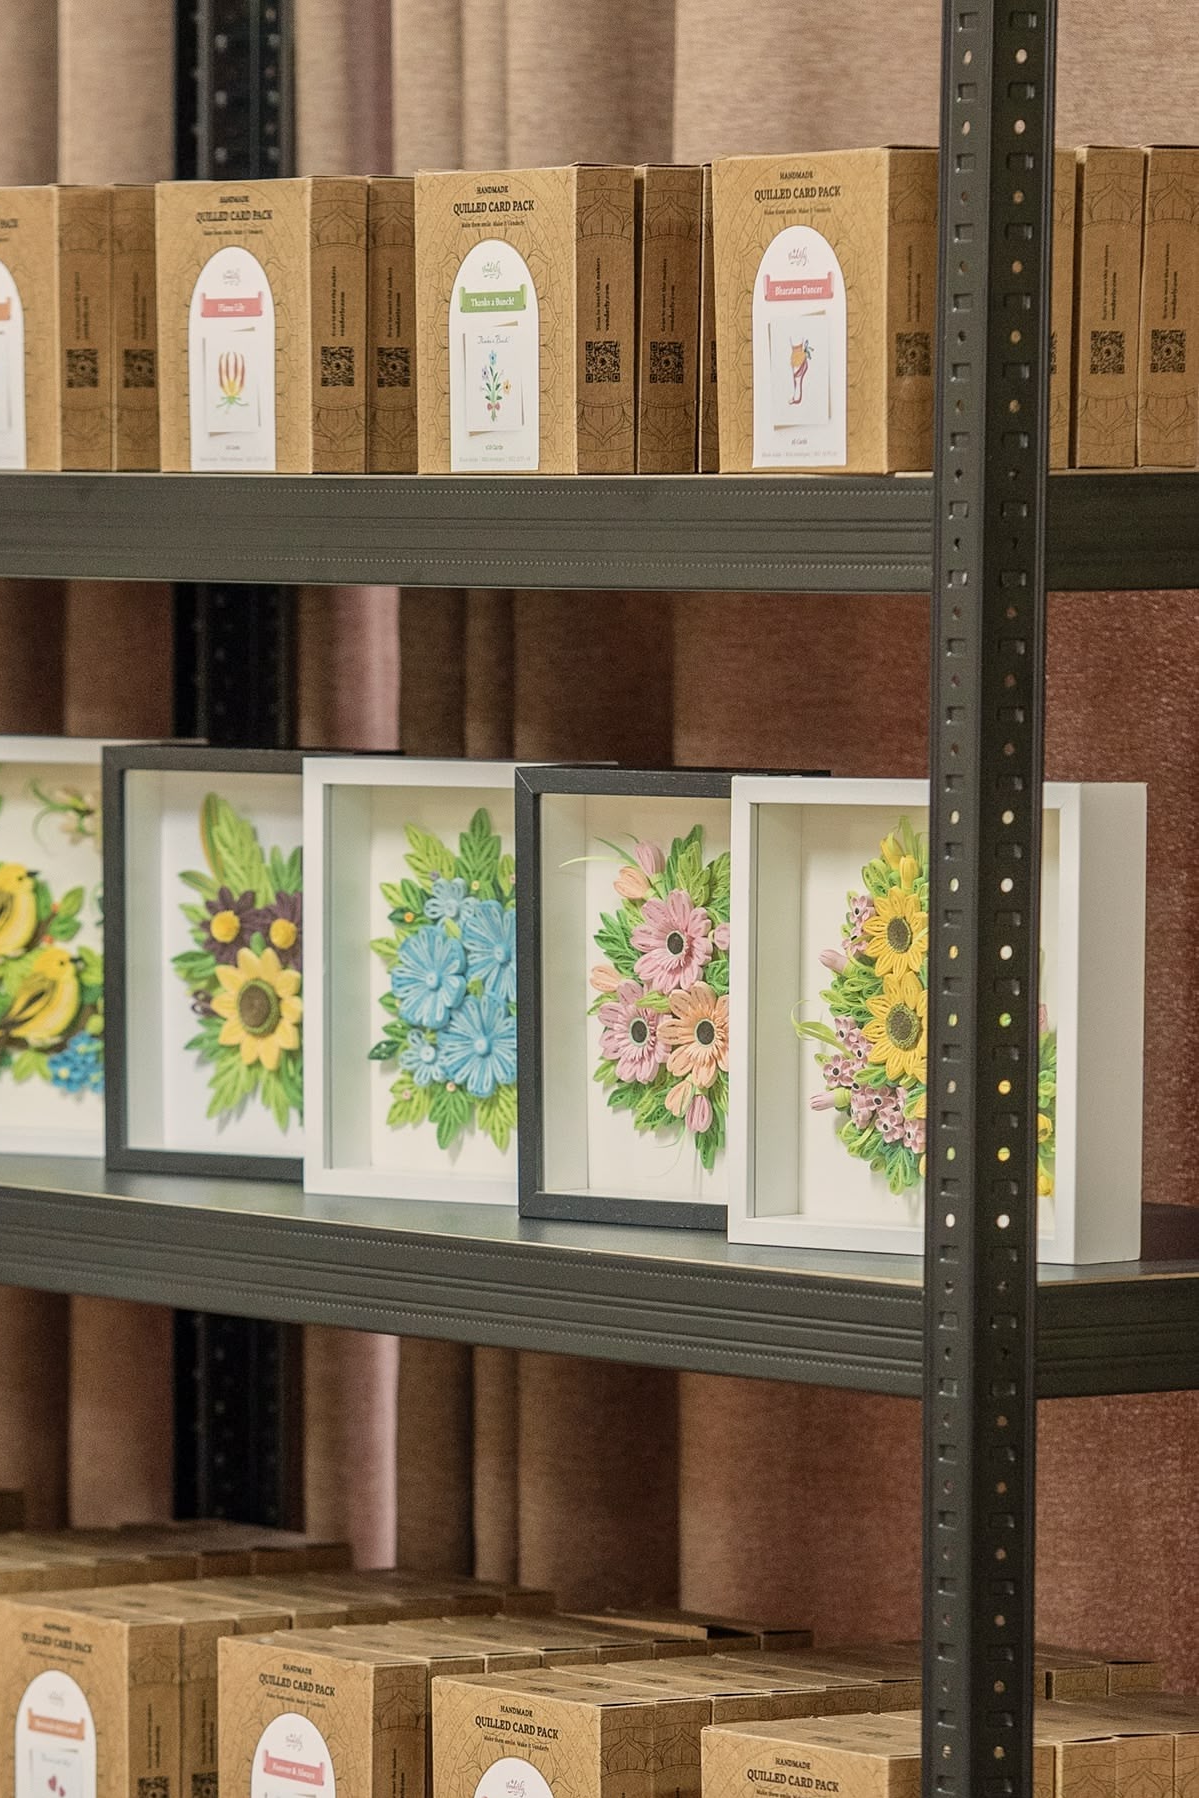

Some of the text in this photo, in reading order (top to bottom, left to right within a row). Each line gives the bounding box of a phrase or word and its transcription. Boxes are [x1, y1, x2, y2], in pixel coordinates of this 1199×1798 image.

[780, 170, 813, 180] HANDMADE
[476, 185, 509, 194] HANDMADE
[754, 185, 841, 203] QUILLED CARD PACK
[453, 200, 535, 216] QUILLED CARD PACK
[471, 298, 490, 307] Thanks
[259, 1673, 336, 1697] QUILLED CARD PACK
[500, 1705, 533, 1717] HANDMADE
[475, 1715, 559, 1740] QUILLED CARD PACK
[775, 1757, 811, 1770] HANDMADE
[747, 1768, 839, 1792] QUILLED CARD PACK
